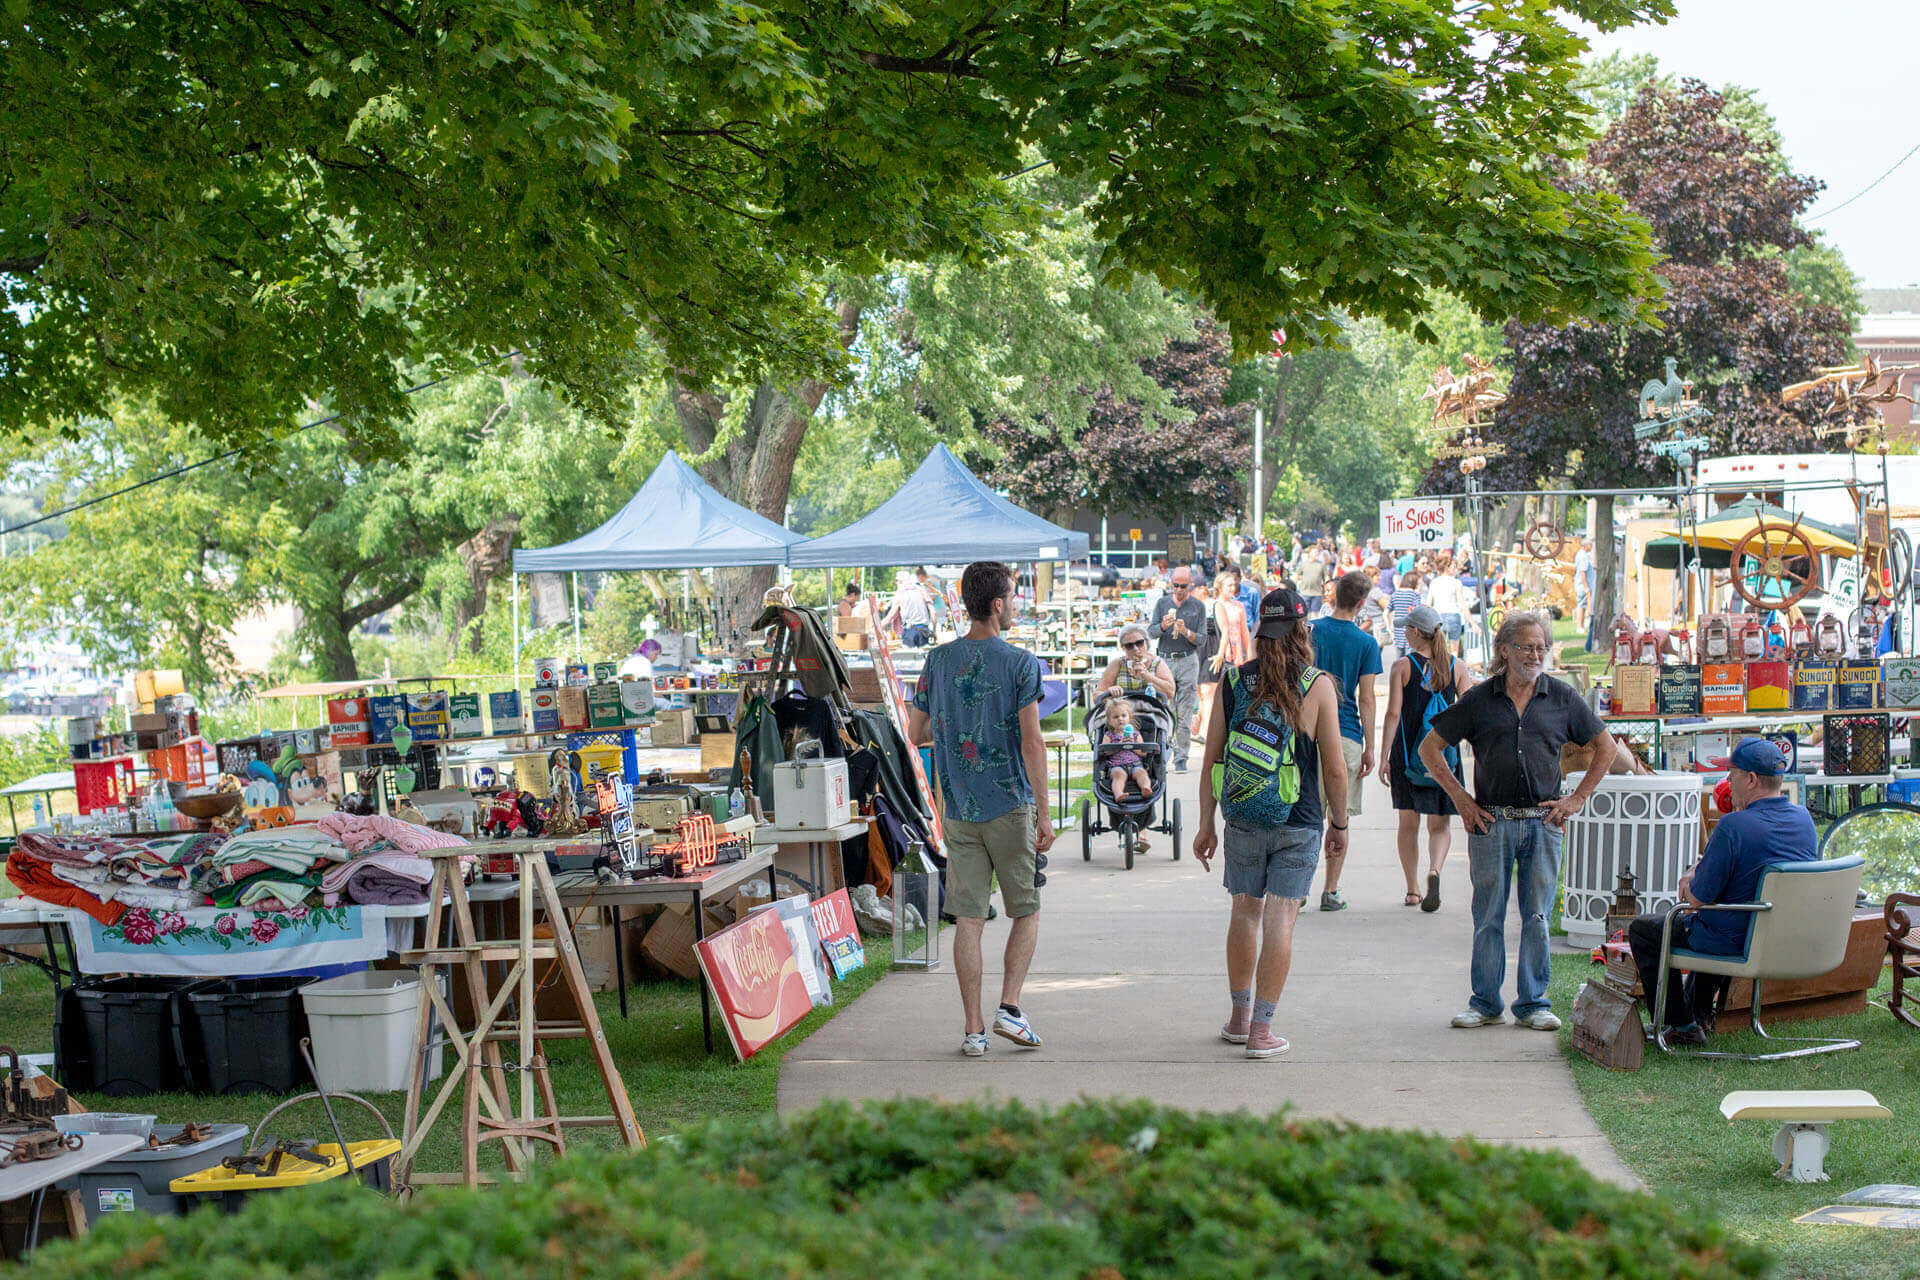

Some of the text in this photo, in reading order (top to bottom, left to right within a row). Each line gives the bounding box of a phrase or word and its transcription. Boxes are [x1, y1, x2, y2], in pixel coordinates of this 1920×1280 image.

[1385, 514, 1403, 534] Tin
[1799, 670, 1833, 683] SUNOCO
[1842, 669, 1877, 681] SUNOCO
[1662, 682, 1698, 693] Guardian
[1243, 721, 1279, 744] WPS
